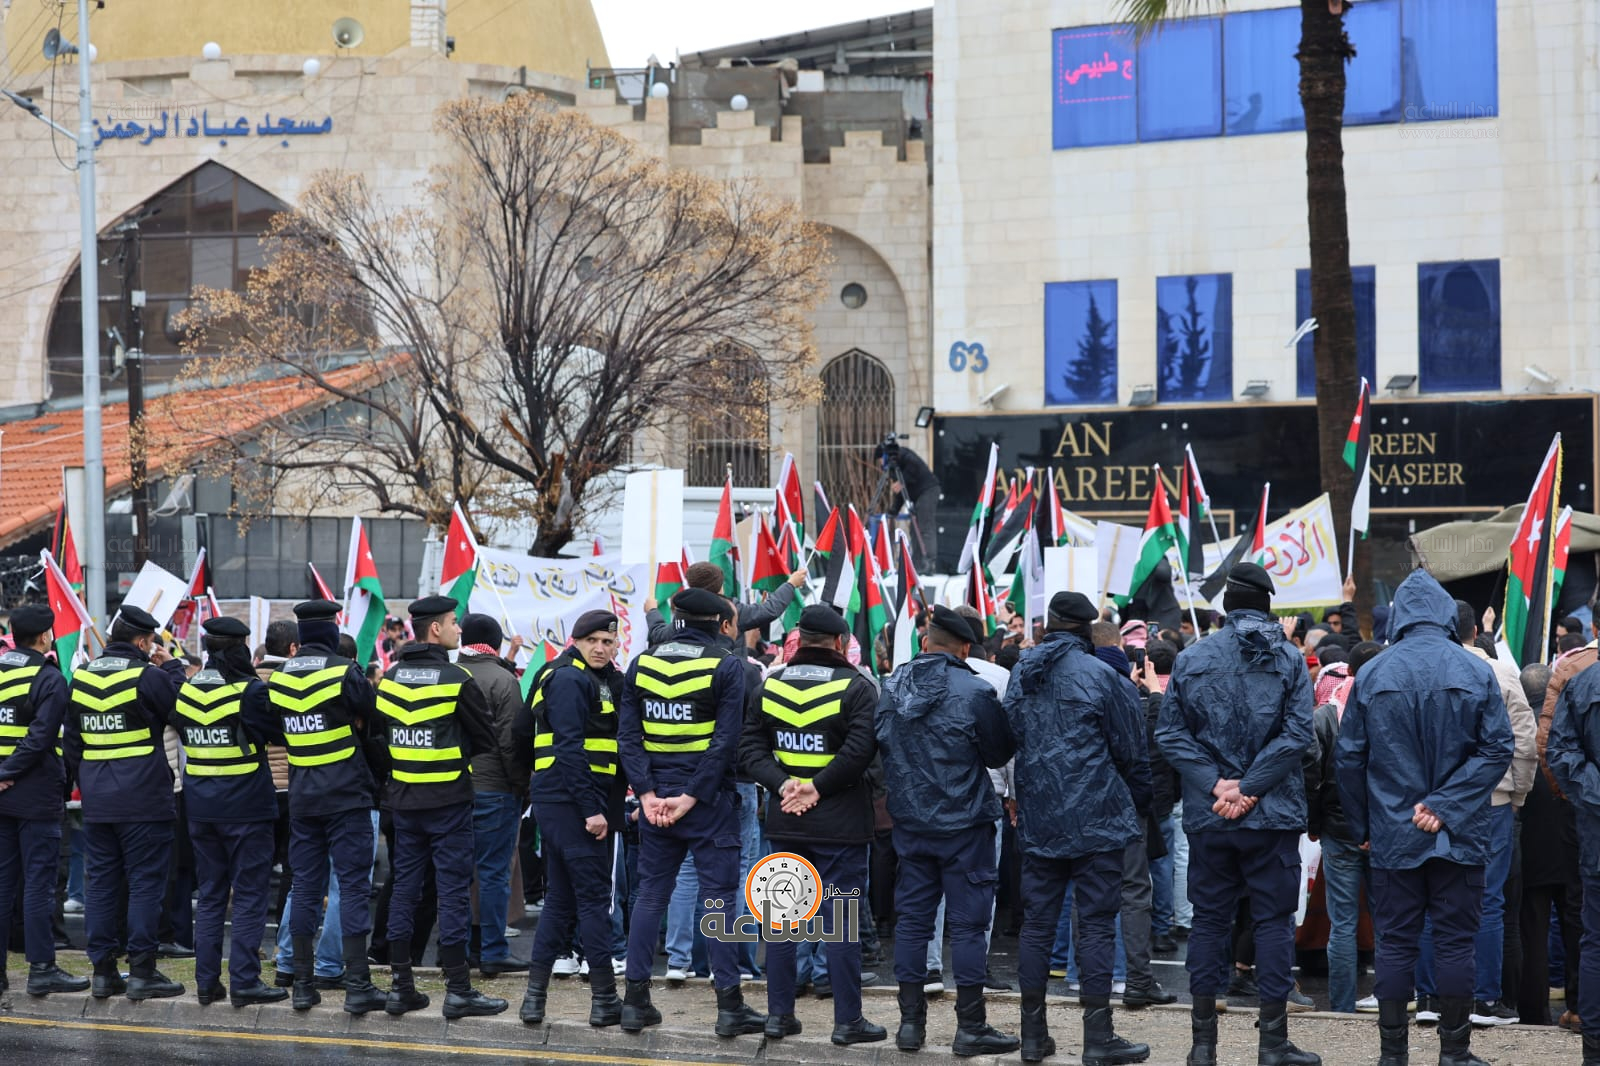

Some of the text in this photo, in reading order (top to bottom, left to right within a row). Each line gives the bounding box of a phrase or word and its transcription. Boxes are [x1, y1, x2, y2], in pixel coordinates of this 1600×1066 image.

[186, 108, 250, 148] عباد
[256, 113, 332, 148] مسجد
[949, 341, 989, 373] 63
[1052, 421, 1114, 460] AN
[1369, 433, 1436, 456] REEN
[1369, 464, 1464, 487] NASEER
[1264, 520, 1325, 577] الأرد
[287, 658, 324, 669] الشرطة
[783, 666, 831, 679] الشرطة
[398, 669, 437, 682] الشرطة
[645, 701, 693, 721] POLICE
[84, 715, 124, 733] POLICE
[284, 714, 325, 733] POLICE
[187, 728, 230, 745] POLICE
[392, 728, 433, 747] POLICE
[776, 730, 825, 752] POLICE
